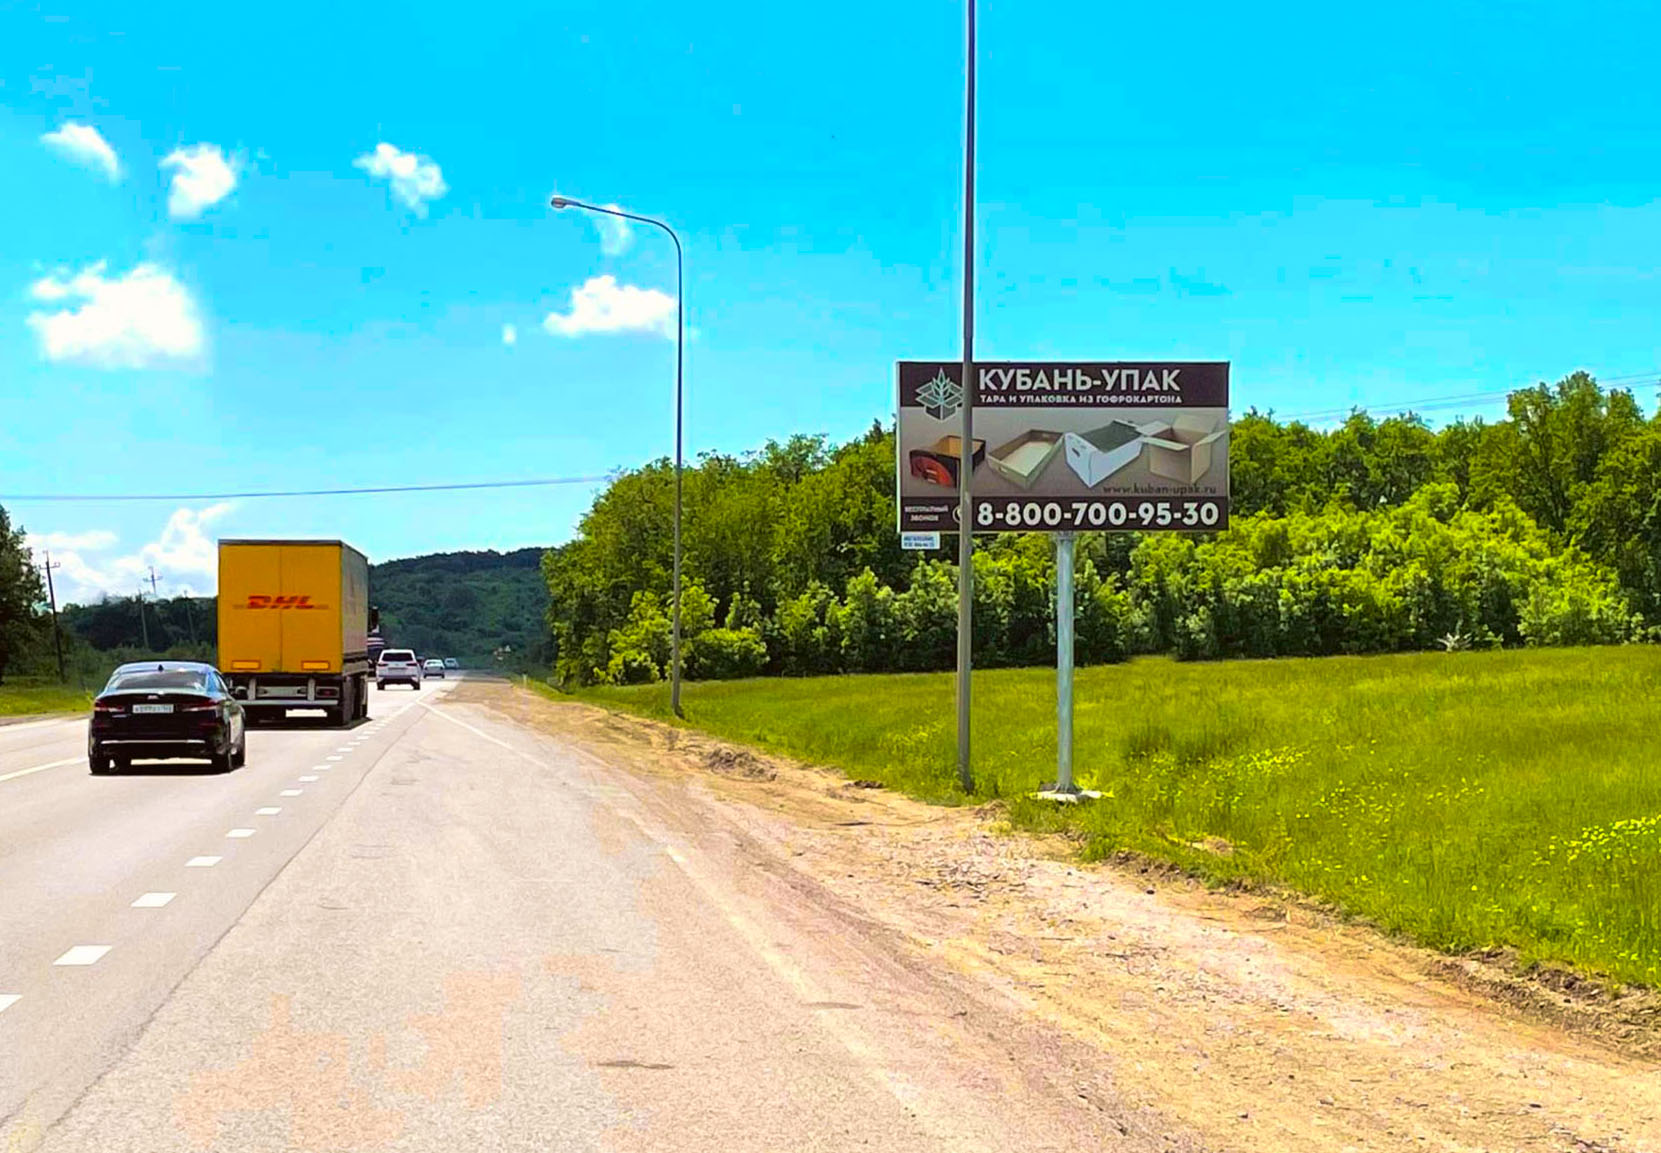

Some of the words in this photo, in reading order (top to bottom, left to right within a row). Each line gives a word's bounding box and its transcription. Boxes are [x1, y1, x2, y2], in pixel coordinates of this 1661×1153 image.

[979, 369, 1181, 391] КУБАНЬ-УПАК
[980, 394, 1006, 404] ТАРА
[1009, 394, 1017, 404] И
[1019, 394, 1077, 404] УПАКОВКА
[1079, 394, 1094, 404] ИЗ
[1096, 394, 1182, 404] ГОФРОКАРТОНА
[1104, 483, 1216, 495] www.kuban-upak.ru
[977, 503, 1218, 526] 8-800-700-95-30
[247, 596, 315, 610] DHL
